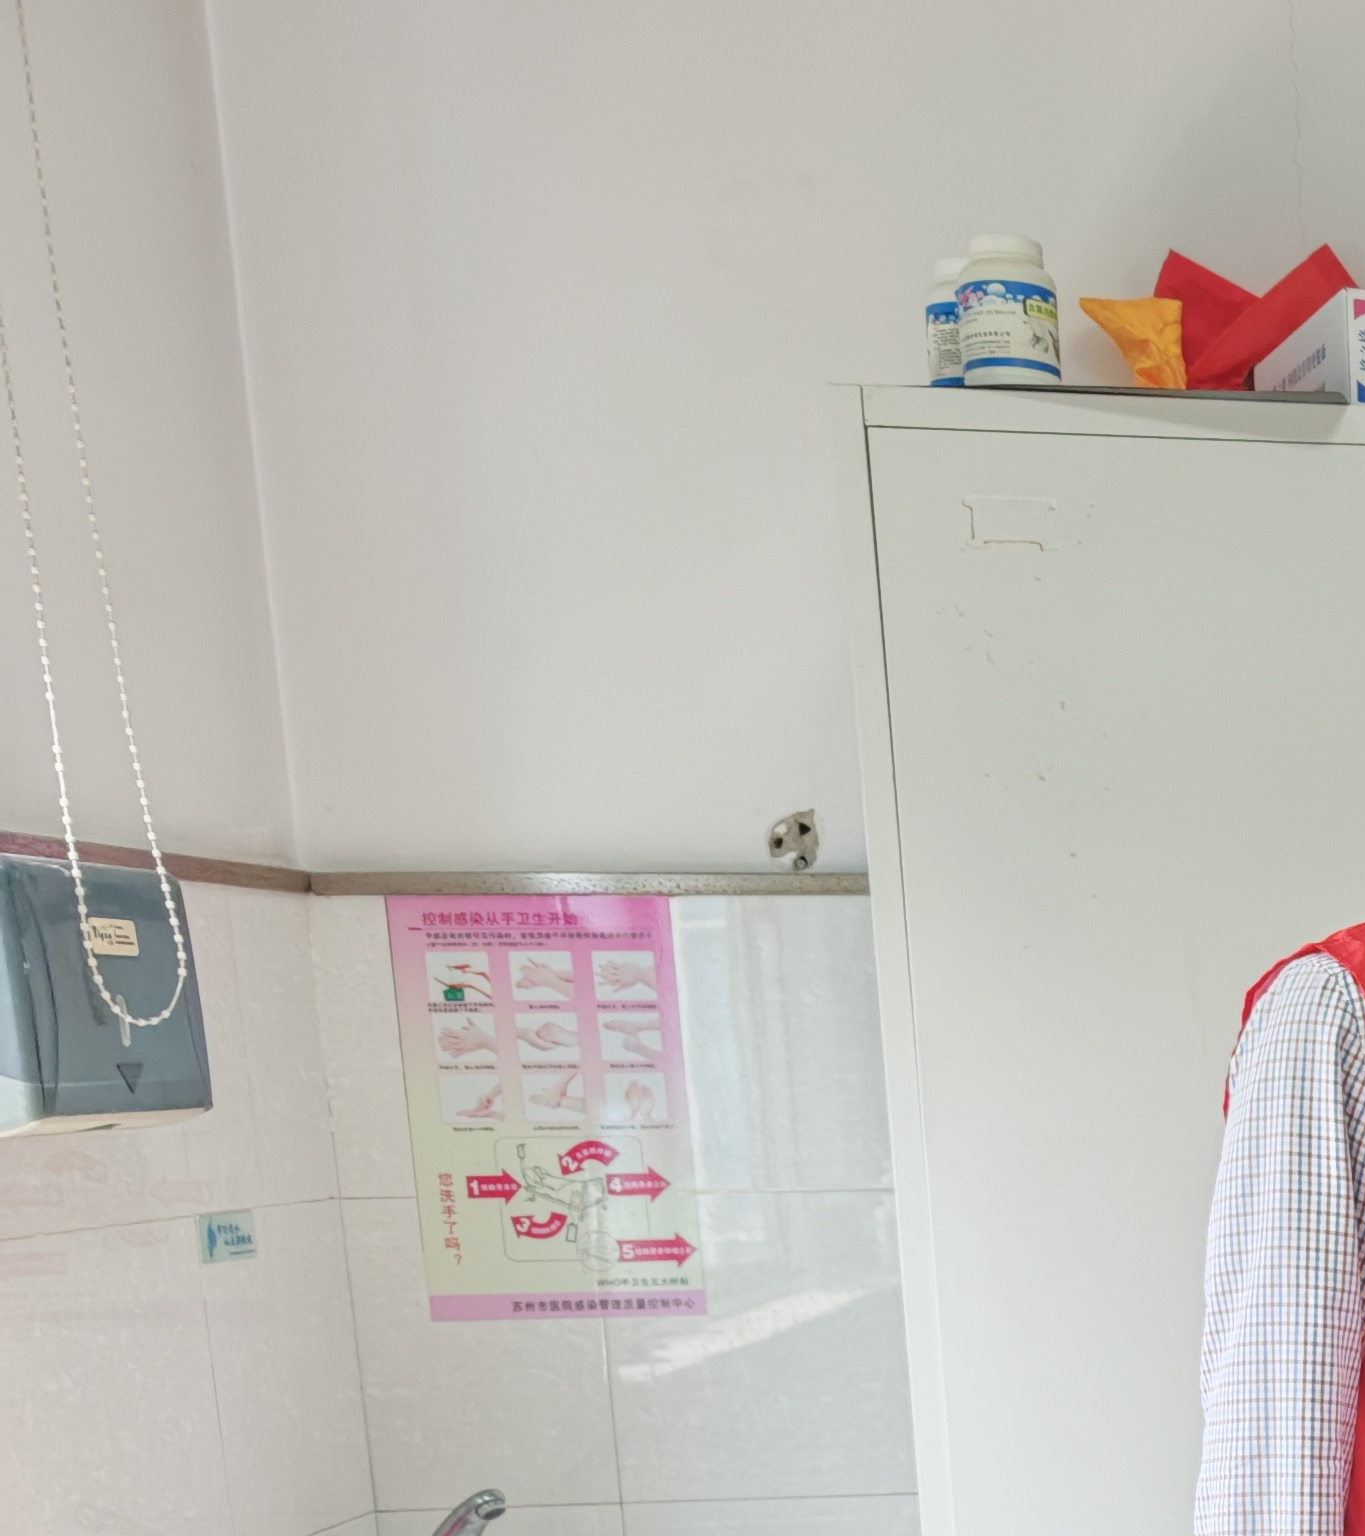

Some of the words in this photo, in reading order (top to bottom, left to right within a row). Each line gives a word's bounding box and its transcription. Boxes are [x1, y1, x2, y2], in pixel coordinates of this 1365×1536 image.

[421, 911, 579, 928] 控制感染从手卫生开始
